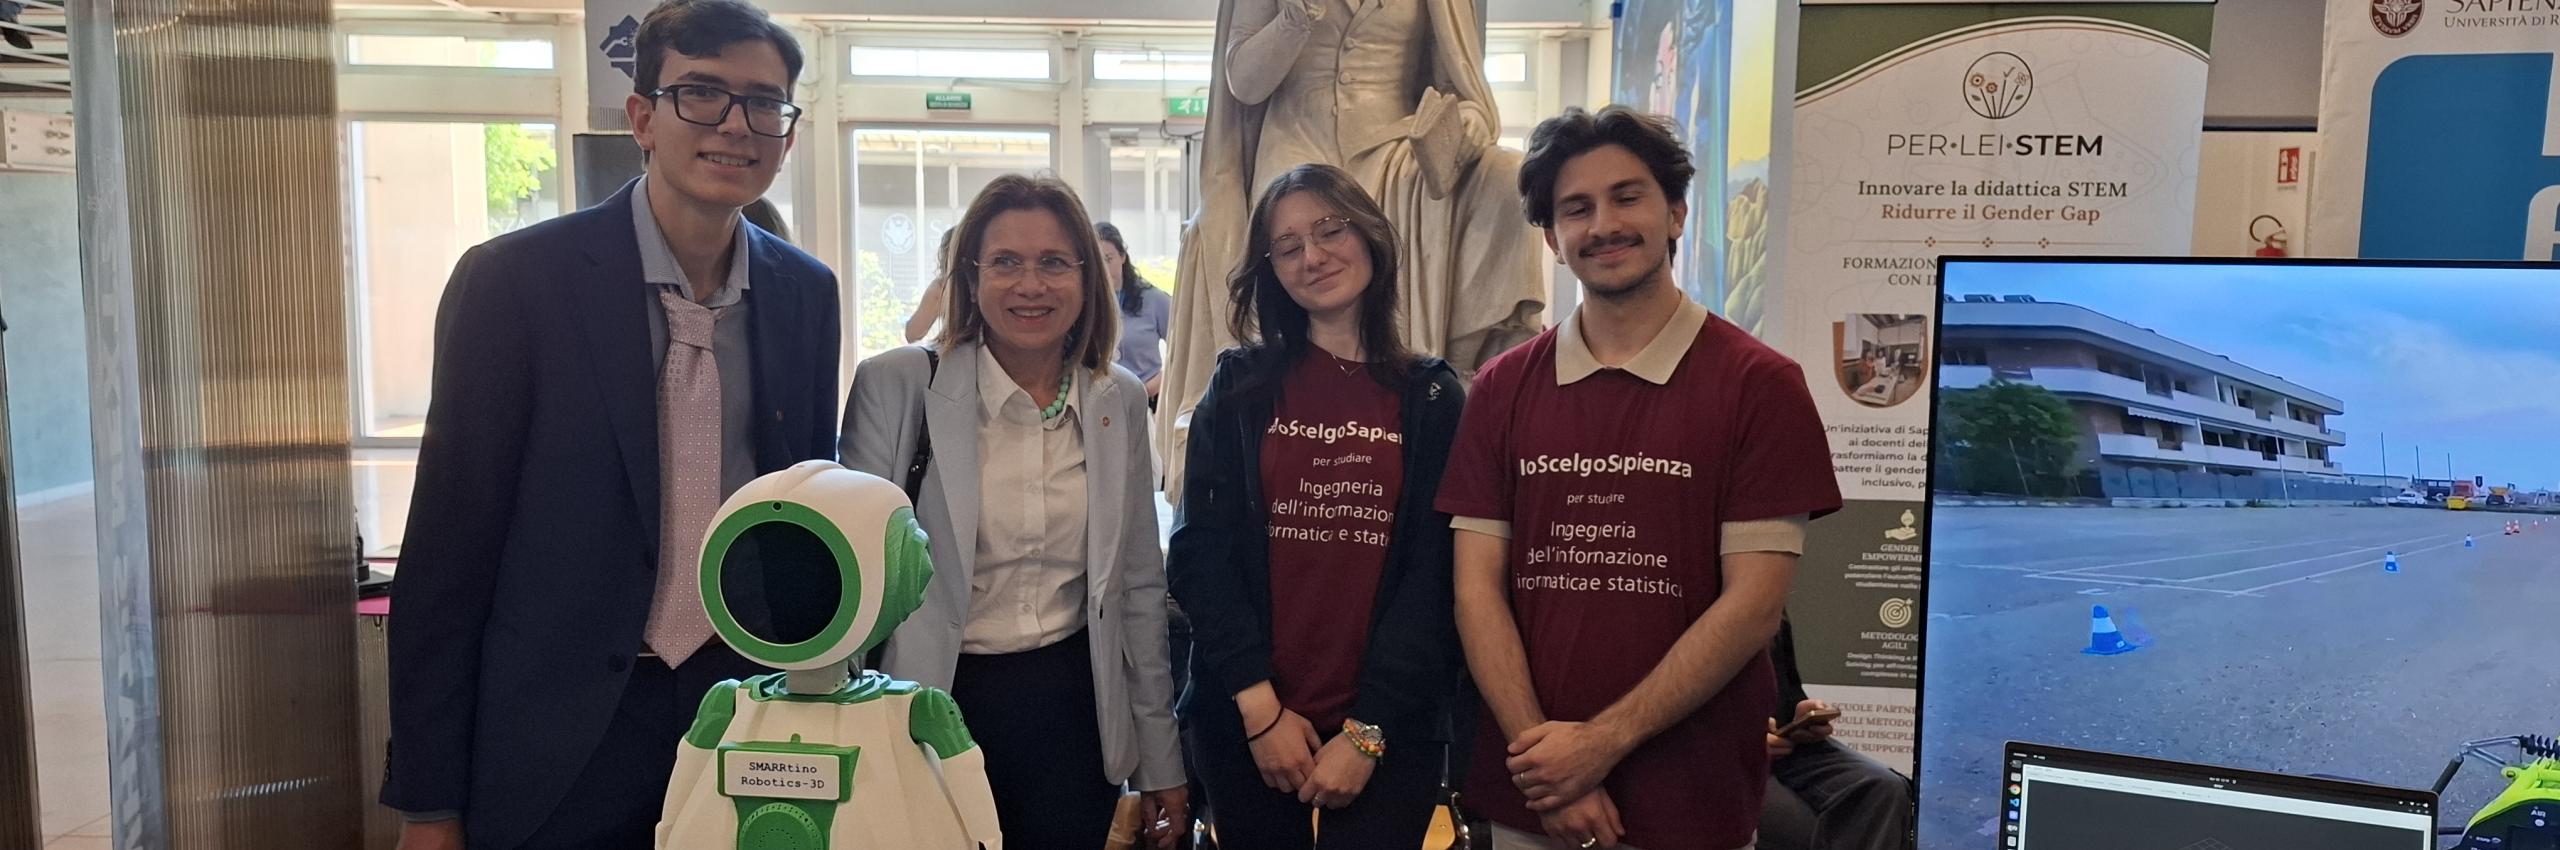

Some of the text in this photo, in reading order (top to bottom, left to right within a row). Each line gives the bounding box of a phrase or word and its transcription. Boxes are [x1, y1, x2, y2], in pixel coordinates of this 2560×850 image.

[1858, 181, 2128, 197] Innovare la didattica STEM
[1881, 204, 2101, 225] Ridurre il Gender Gap
[1888, 273, 1921, 286] CON
[1894, 425, 1906, 434] di
[1848, 438, 1858, 446] ai
[1861, 438, 1905, 447] docenti
[1312, 453, 1372, 467] per studiare
[1907, 452, 1917, 461] la
[1875, 464, 1881, 473] il
[1299, 477, 1383, 499] Ingegneria
[1861, 478, 1915, 488] inclusivo,
[1567, 494, 1584, 506] per
[1338, 528, 1349, 540] e
[1880, 544, 1919, 552] GENDER
[1882, 642, 1907, 650] AGILI
[749, 761, 818, 774] SMARRtino
[741, 776, 825, 789] Robotics-3D
